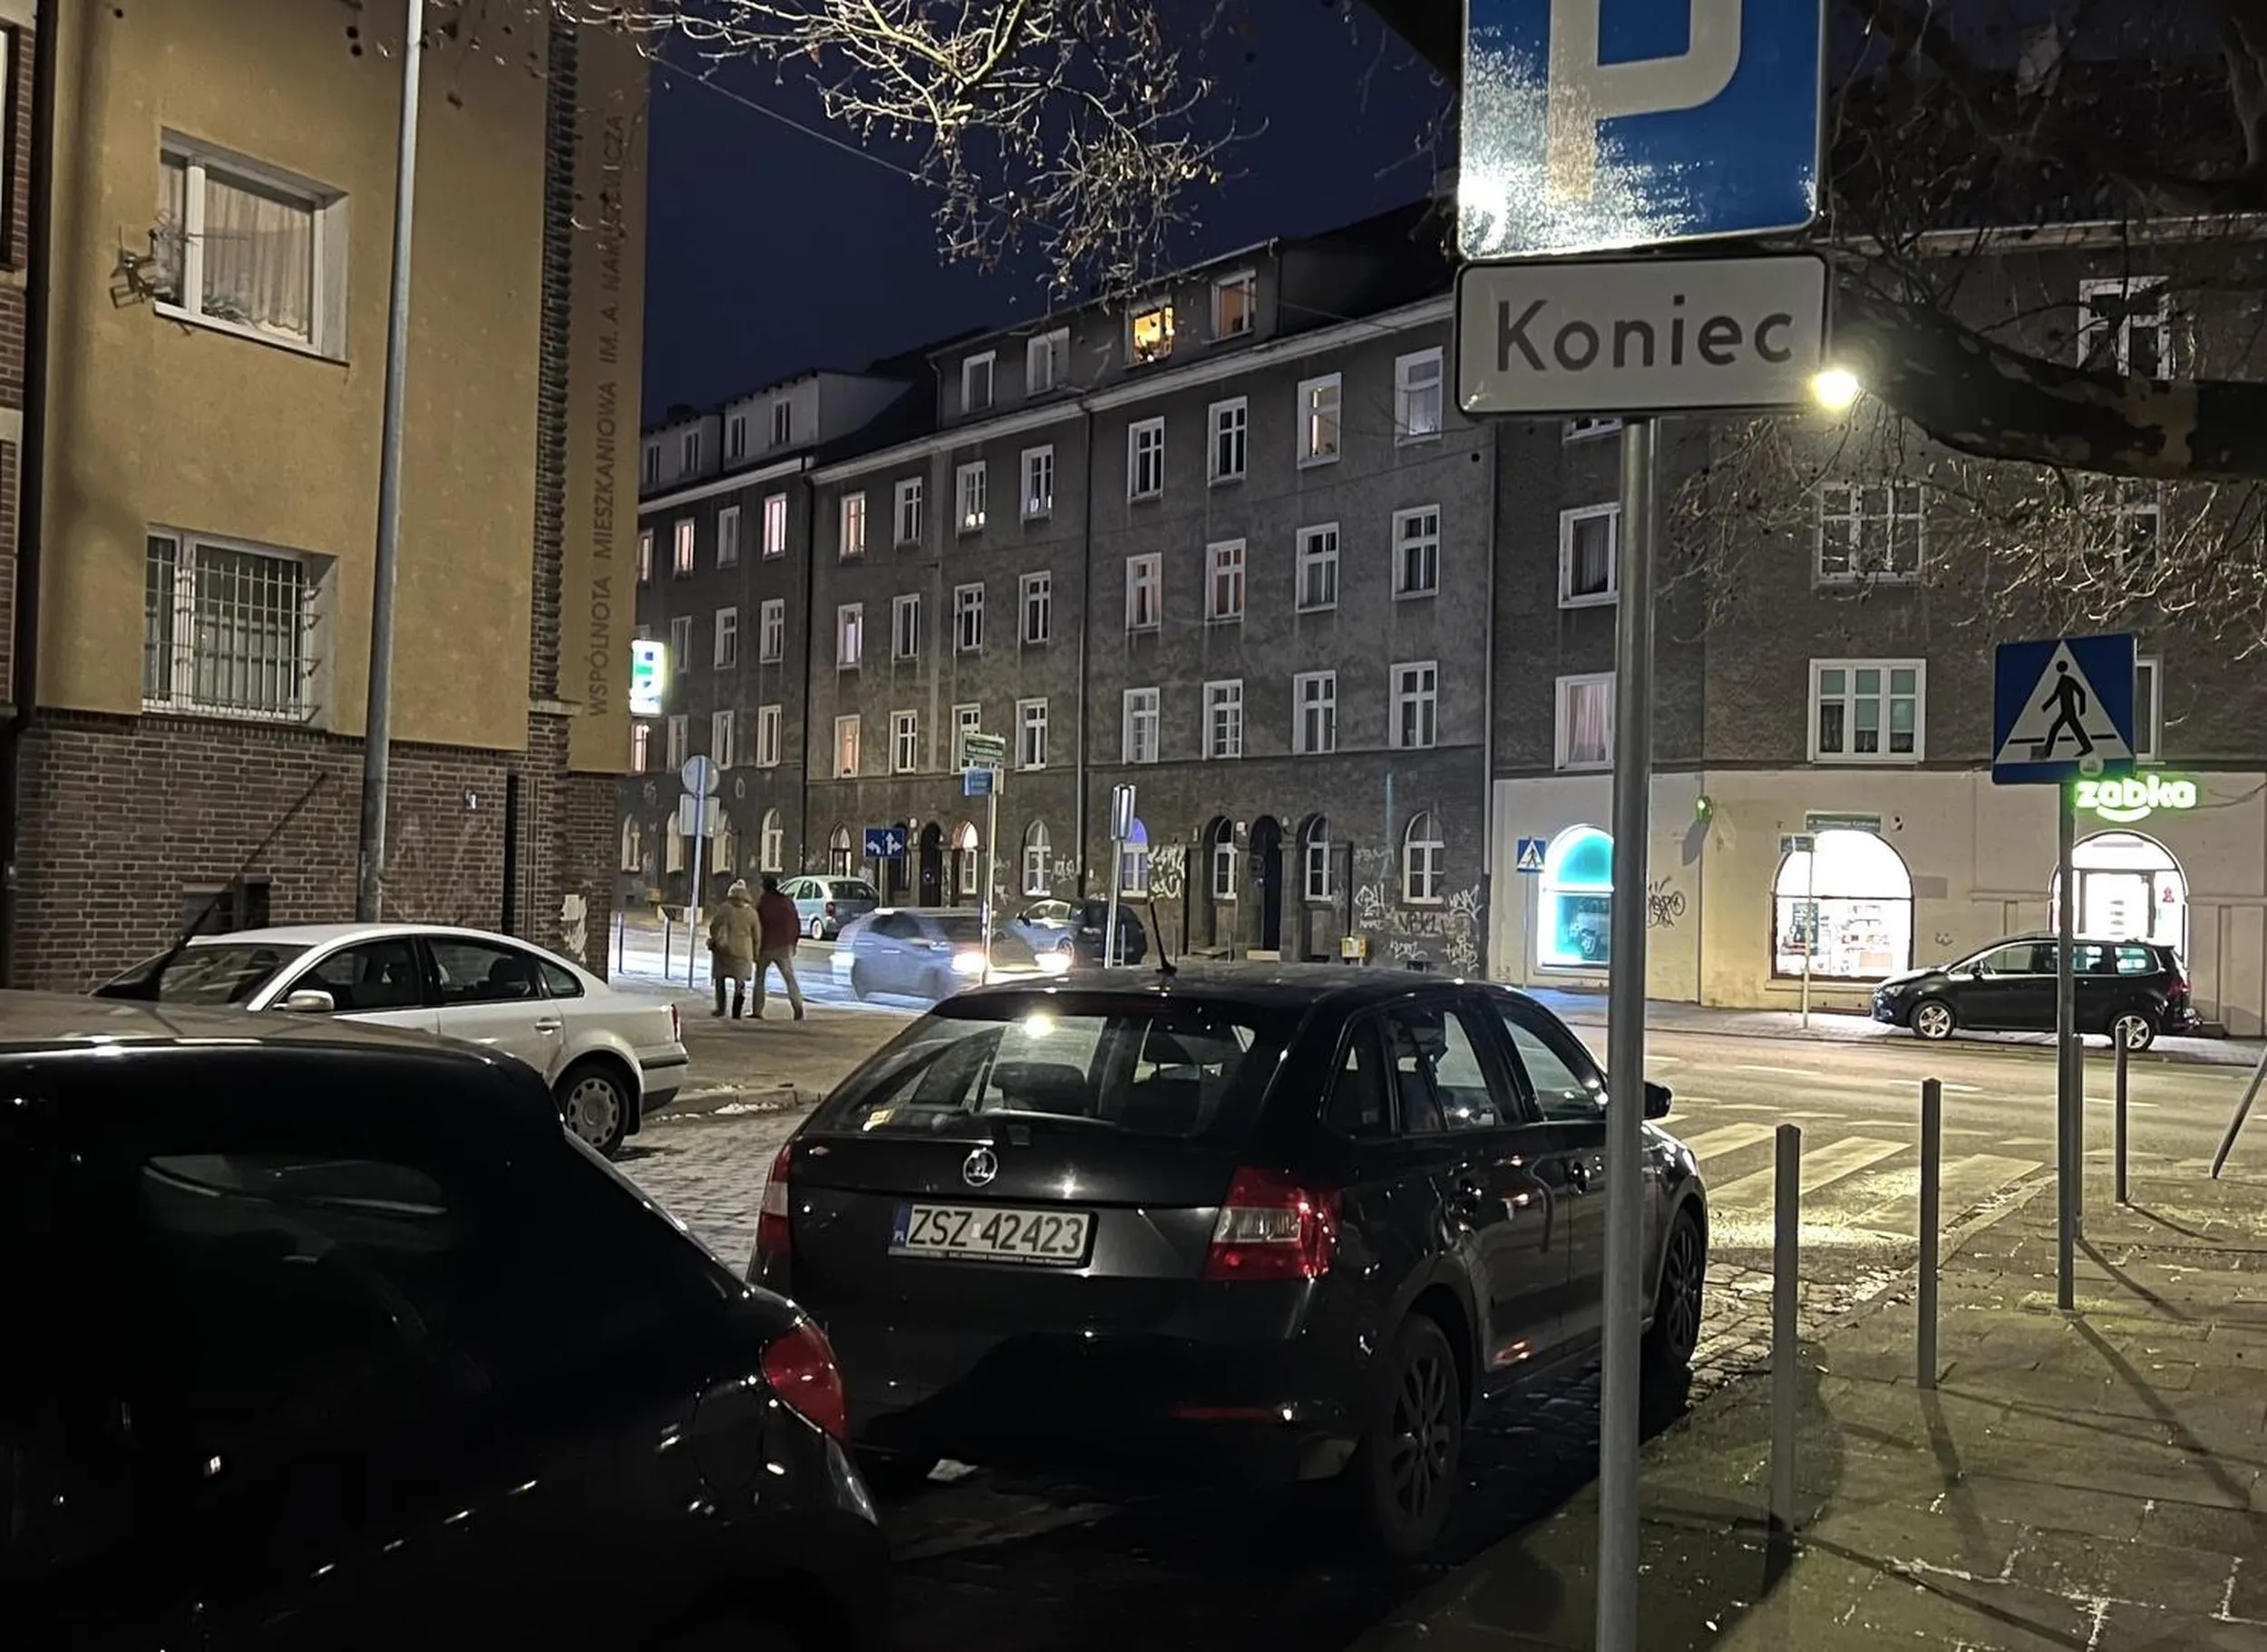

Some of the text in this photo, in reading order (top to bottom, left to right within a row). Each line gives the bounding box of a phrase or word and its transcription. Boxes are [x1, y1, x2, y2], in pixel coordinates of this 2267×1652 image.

[600, 302, 620, 325] A.
[1496, 295, 1794, 373] Koniec
[598, 332, 618, 364] IM.
[592, 382, 618, 559] MIESZKANIOWA
[585, 576, 611, 717] WSPÓLNOTA
[909, 1209, 1084, 1253] ZSZ 42423
